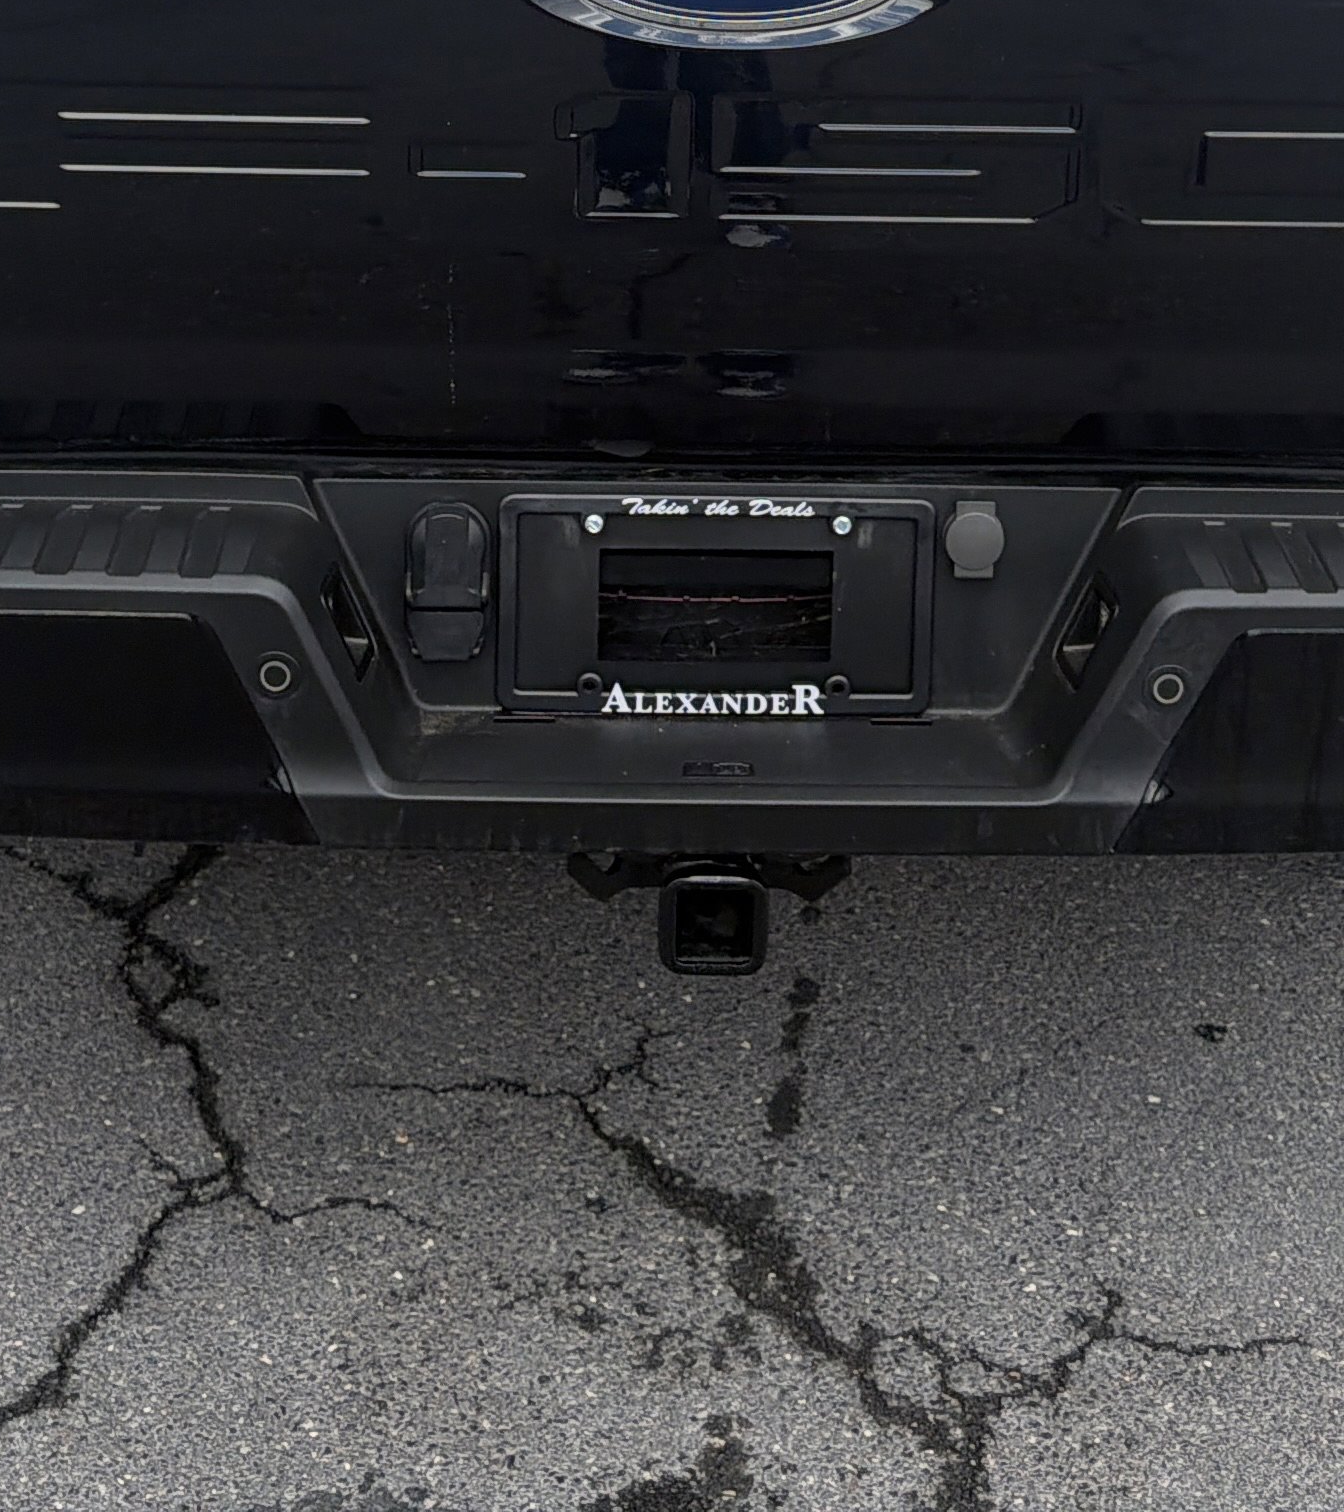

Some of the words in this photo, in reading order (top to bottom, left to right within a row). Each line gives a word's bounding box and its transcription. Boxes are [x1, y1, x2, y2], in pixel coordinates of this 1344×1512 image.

[621, 497, 699, 516] Takin'
[705, 497, 740, 516] the
[749, 498, 816, 517] Deals
[601, 682, 825, 715] ALEXANDER
